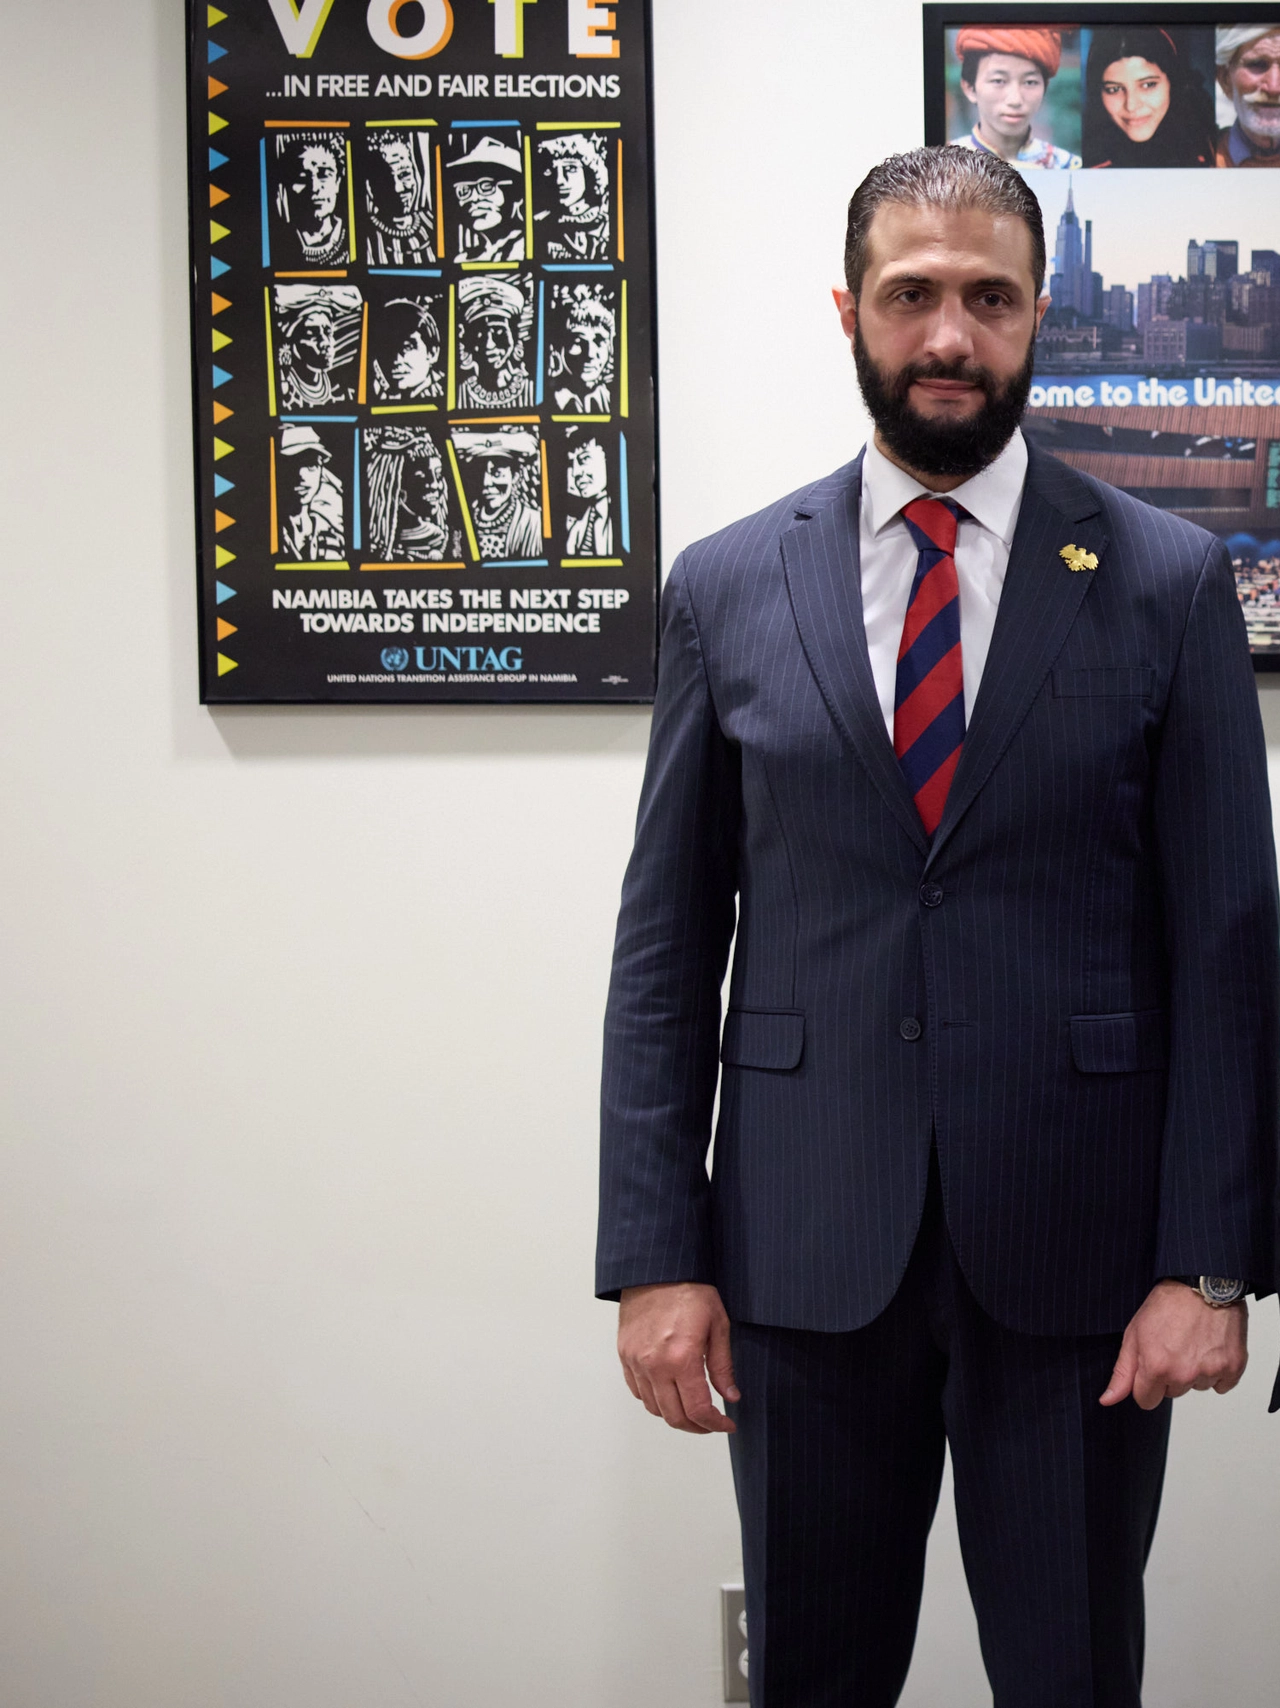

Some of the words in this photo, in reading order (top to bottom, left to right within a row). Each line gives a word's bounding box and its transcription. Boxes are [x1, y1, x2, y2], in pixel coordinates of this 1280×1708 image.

[268, 0, 621, 60] VOTE
[316, 74, 370, 97] FREE
[373, 74, 433, 97] AND
[438, 74, 490, 97] FAIR
[494, 74, 621, 98] ELECTIONS
[1100, 381, 1133, 407] to
[1137, 377, 1189, 407] the
[272, 588, 378, 609] NAMIBIA
[382, 588, 453, 610] TAKES
[459, 588, 502, 609] THE
[509, 588, 572, 609] NEXT
[577, 588, 630, 609] STEP
[299, 612, 415, 633] TOWARDS
[421, 612, 601, 633] INDEPENDENCE
[414, 646, 524, 671] UNTAG
[327, 673, 357, 683] UNITED
[358, 673, 396, 683] NATIONS
[396, 673, 446, 683] TRANSITION
[447, 673, 496, 683] ASSISTANCE
[496, 673, 527, 683] GROUP
[528, 673, 539, 683] IN
[540, 673, 578, 683] NAMIBIA
